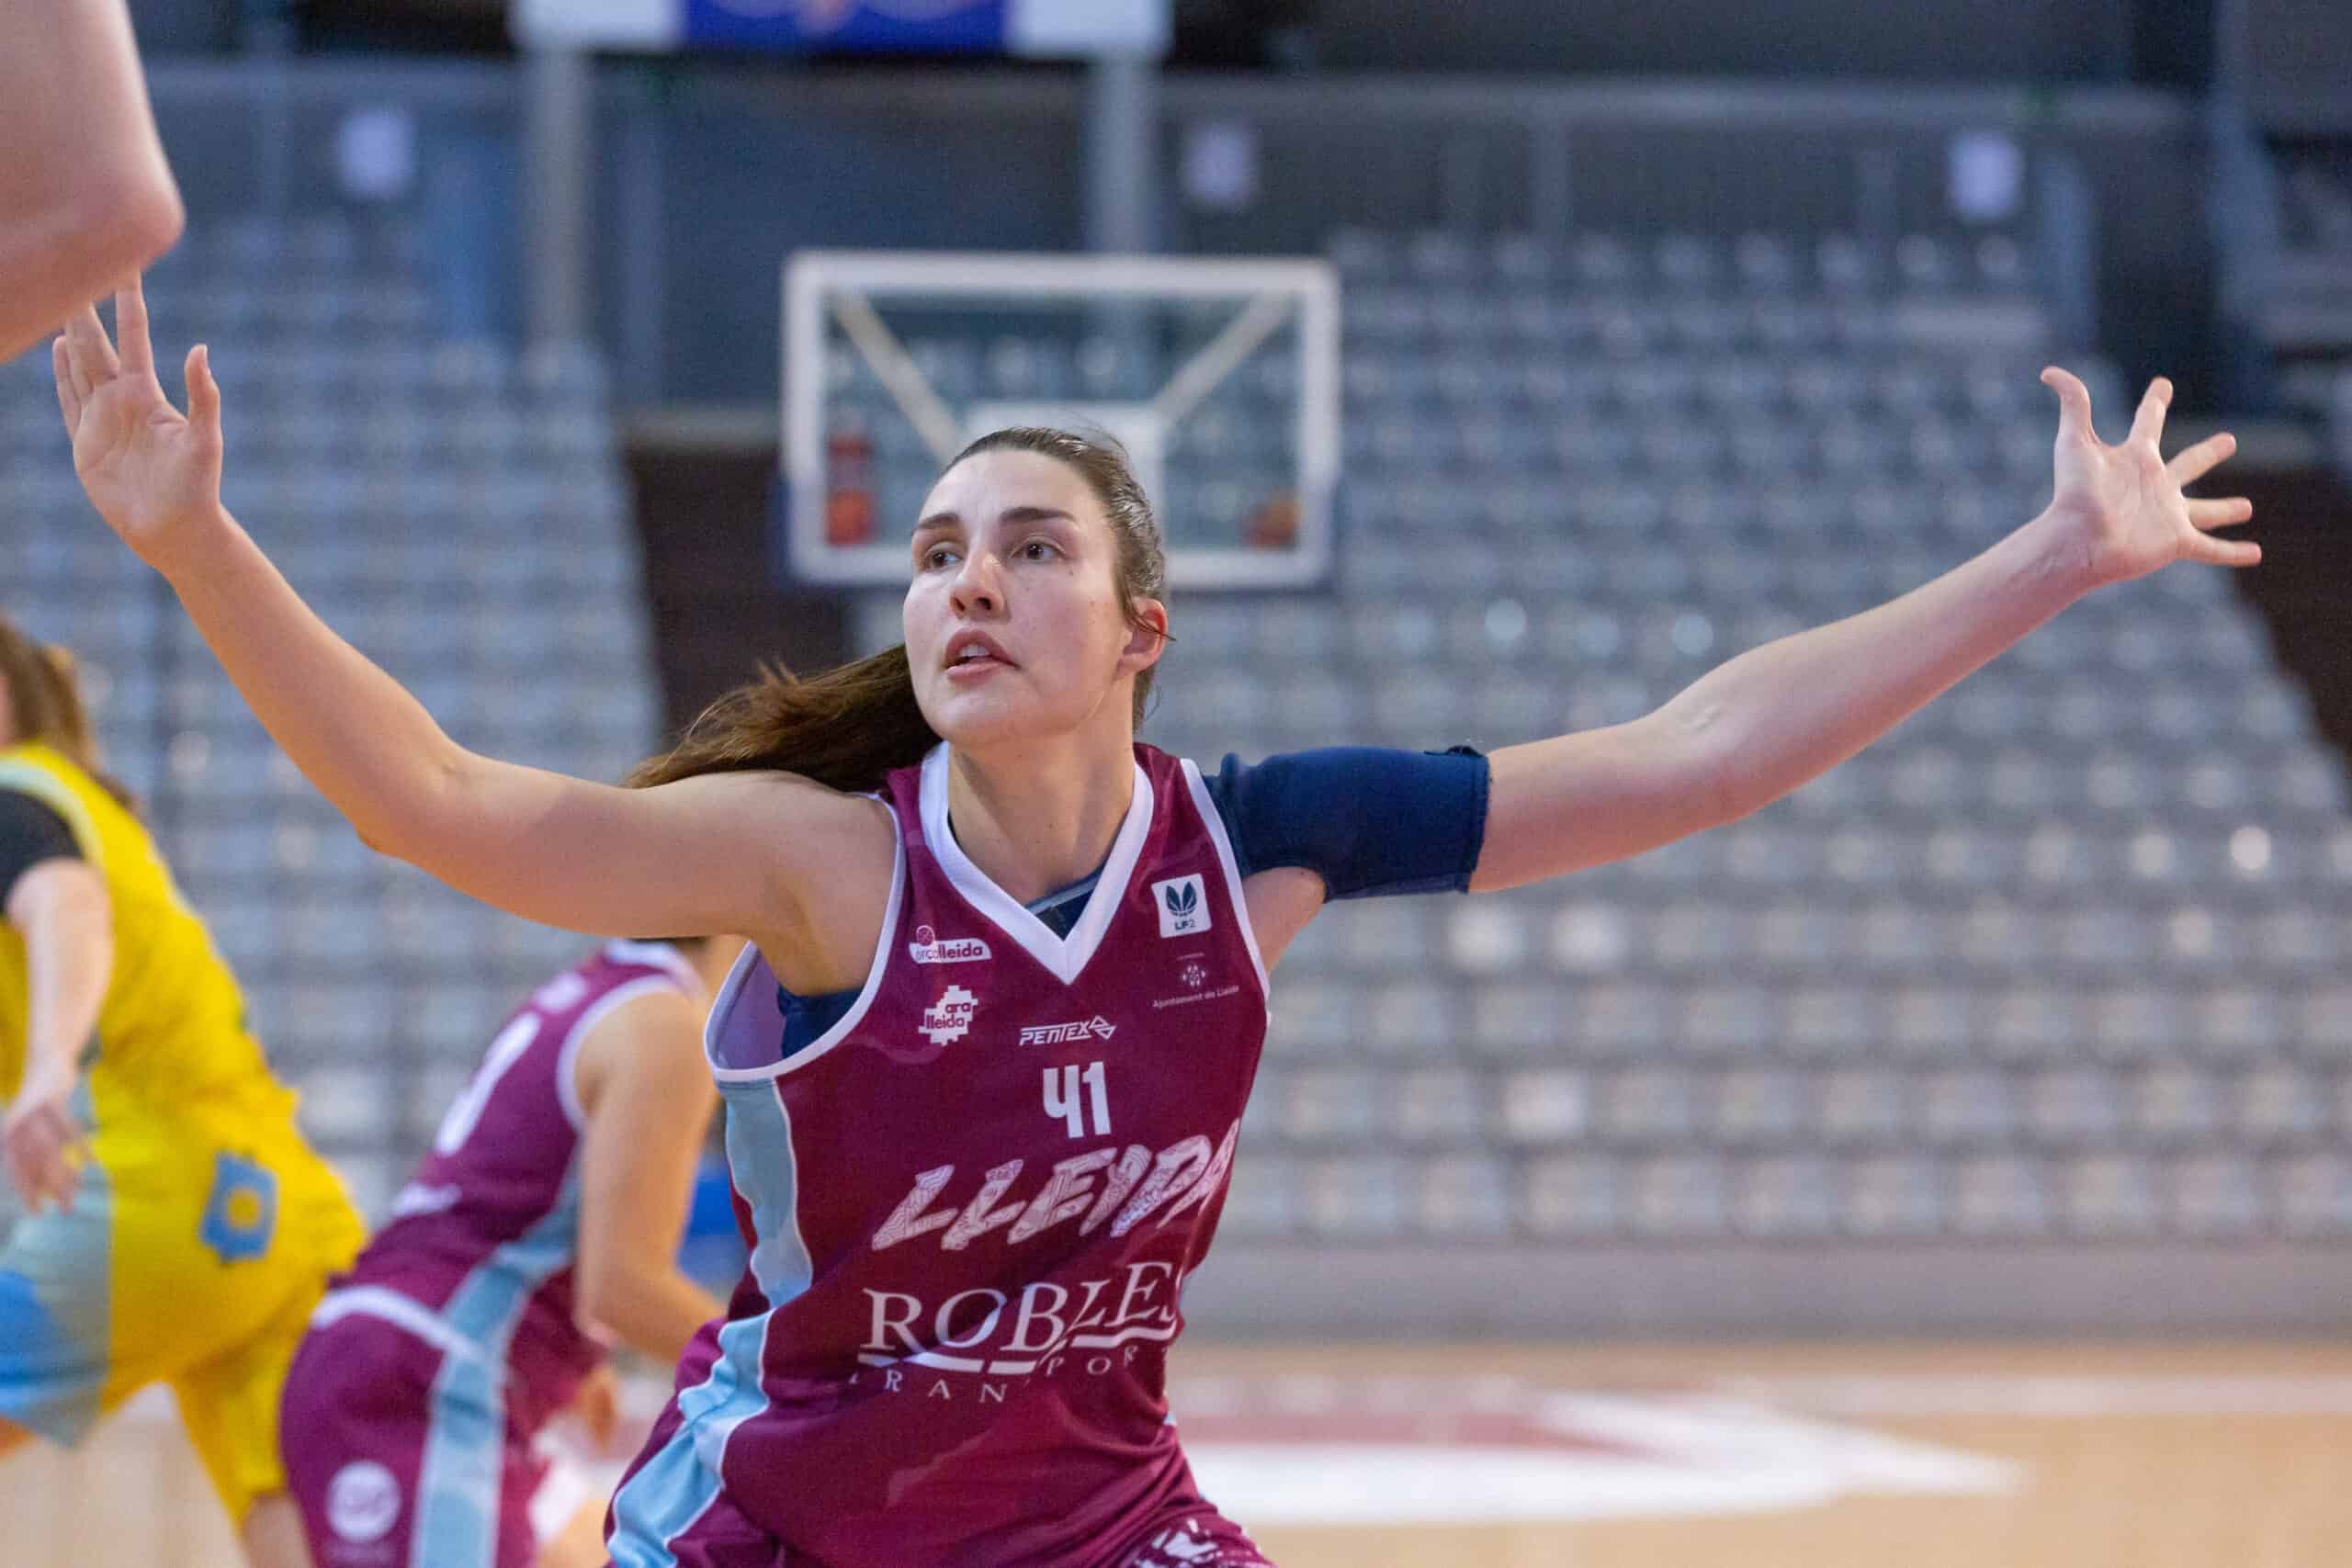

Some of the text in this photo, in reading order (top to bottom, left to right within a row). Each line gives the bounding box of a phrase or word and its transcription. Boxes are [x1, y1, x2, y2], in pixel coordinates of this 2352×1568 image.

[945, 1002, 971, 1014] ara
[926, 1013, 966, 1030] lleida
[1019, 1021, 1092, 1046] PENTEX
[1043, 1061, 1111, 1139] 41
